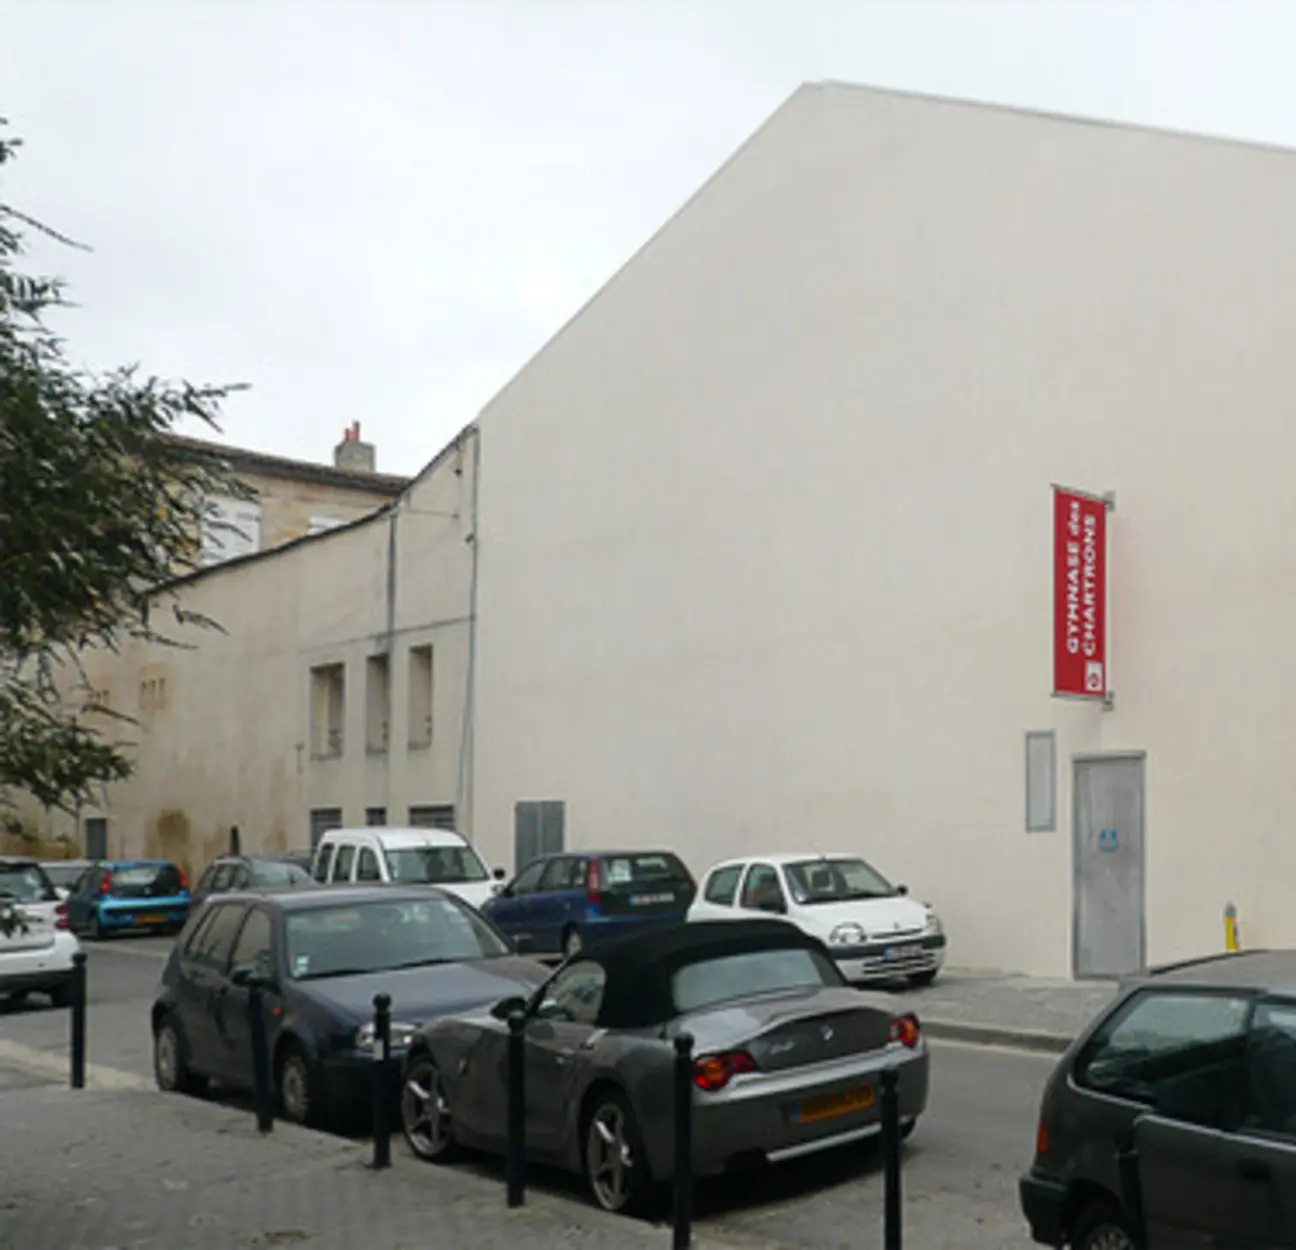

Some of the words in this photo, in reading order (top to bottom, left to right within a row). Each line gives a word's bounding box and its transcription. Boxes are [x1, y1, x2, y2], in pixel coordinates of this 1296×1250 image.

[1069, 501, 1080, 536] des
[1067, 541, 1079, 655] GYMNASE
[1084, 514, 1096, 657] CHARTRONS
